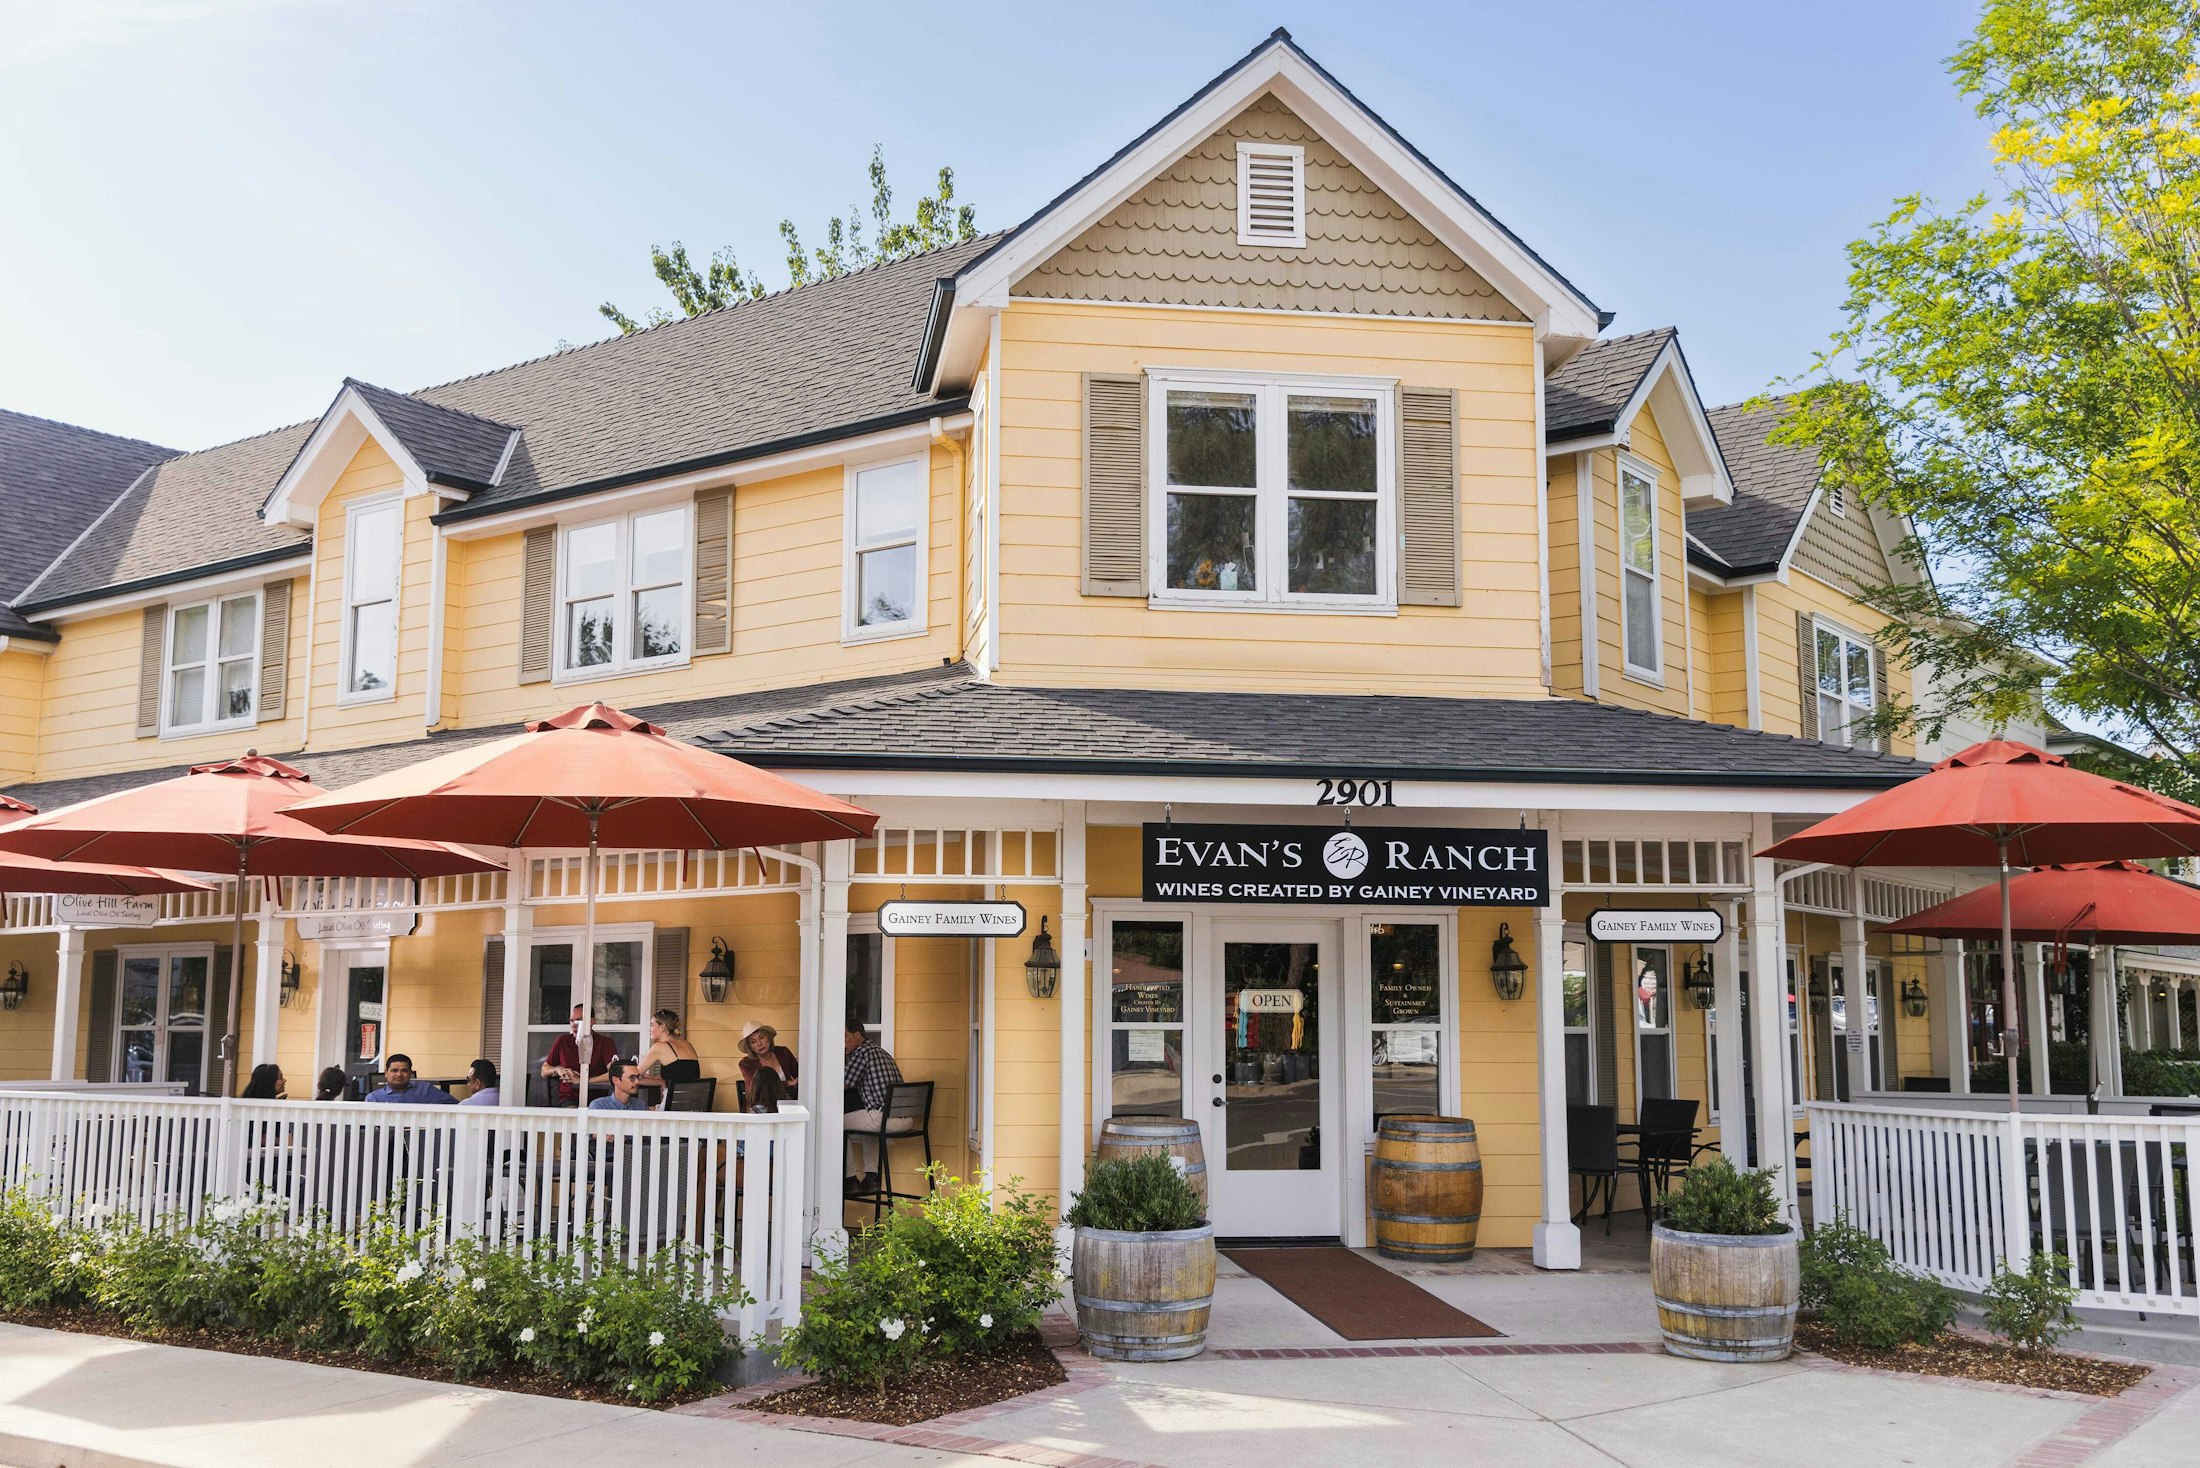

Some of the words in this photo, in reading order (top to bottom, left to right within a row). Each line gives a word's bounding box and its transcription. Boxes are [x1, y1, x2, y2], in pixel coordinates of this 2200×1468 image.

[1316, 779, 1396, 806] 2901
[1156, 838, 1302, 868] EVAN'S
[1385, 841, 1536, 871] RANCH
[1156, 883, 1223, 896] WINES
[1228, 884, 1323, 897] CREATED
[1329, 885, 1354, 898] BY
[1359, 886, 1434, 899] GAINEY
[1438, 887, 1538, 900] VINEYARD
[62, 895, 92, 907] Olive
[96, 896, 116, 908] Hill
[121, 897, 153, 909] Farm
[888, 913, 932, 924] GAINEY
[936, 913, 976, 924] FAMILY
[979, 913, 1017, 924] WINES
[1598, 920, 1637, 930] GAINEY
[1640, 921, 1677, 931] FAMILY
[1680, 920, 1714, 931] WINES
[1253, 994, 1291, 1006] OPEN
